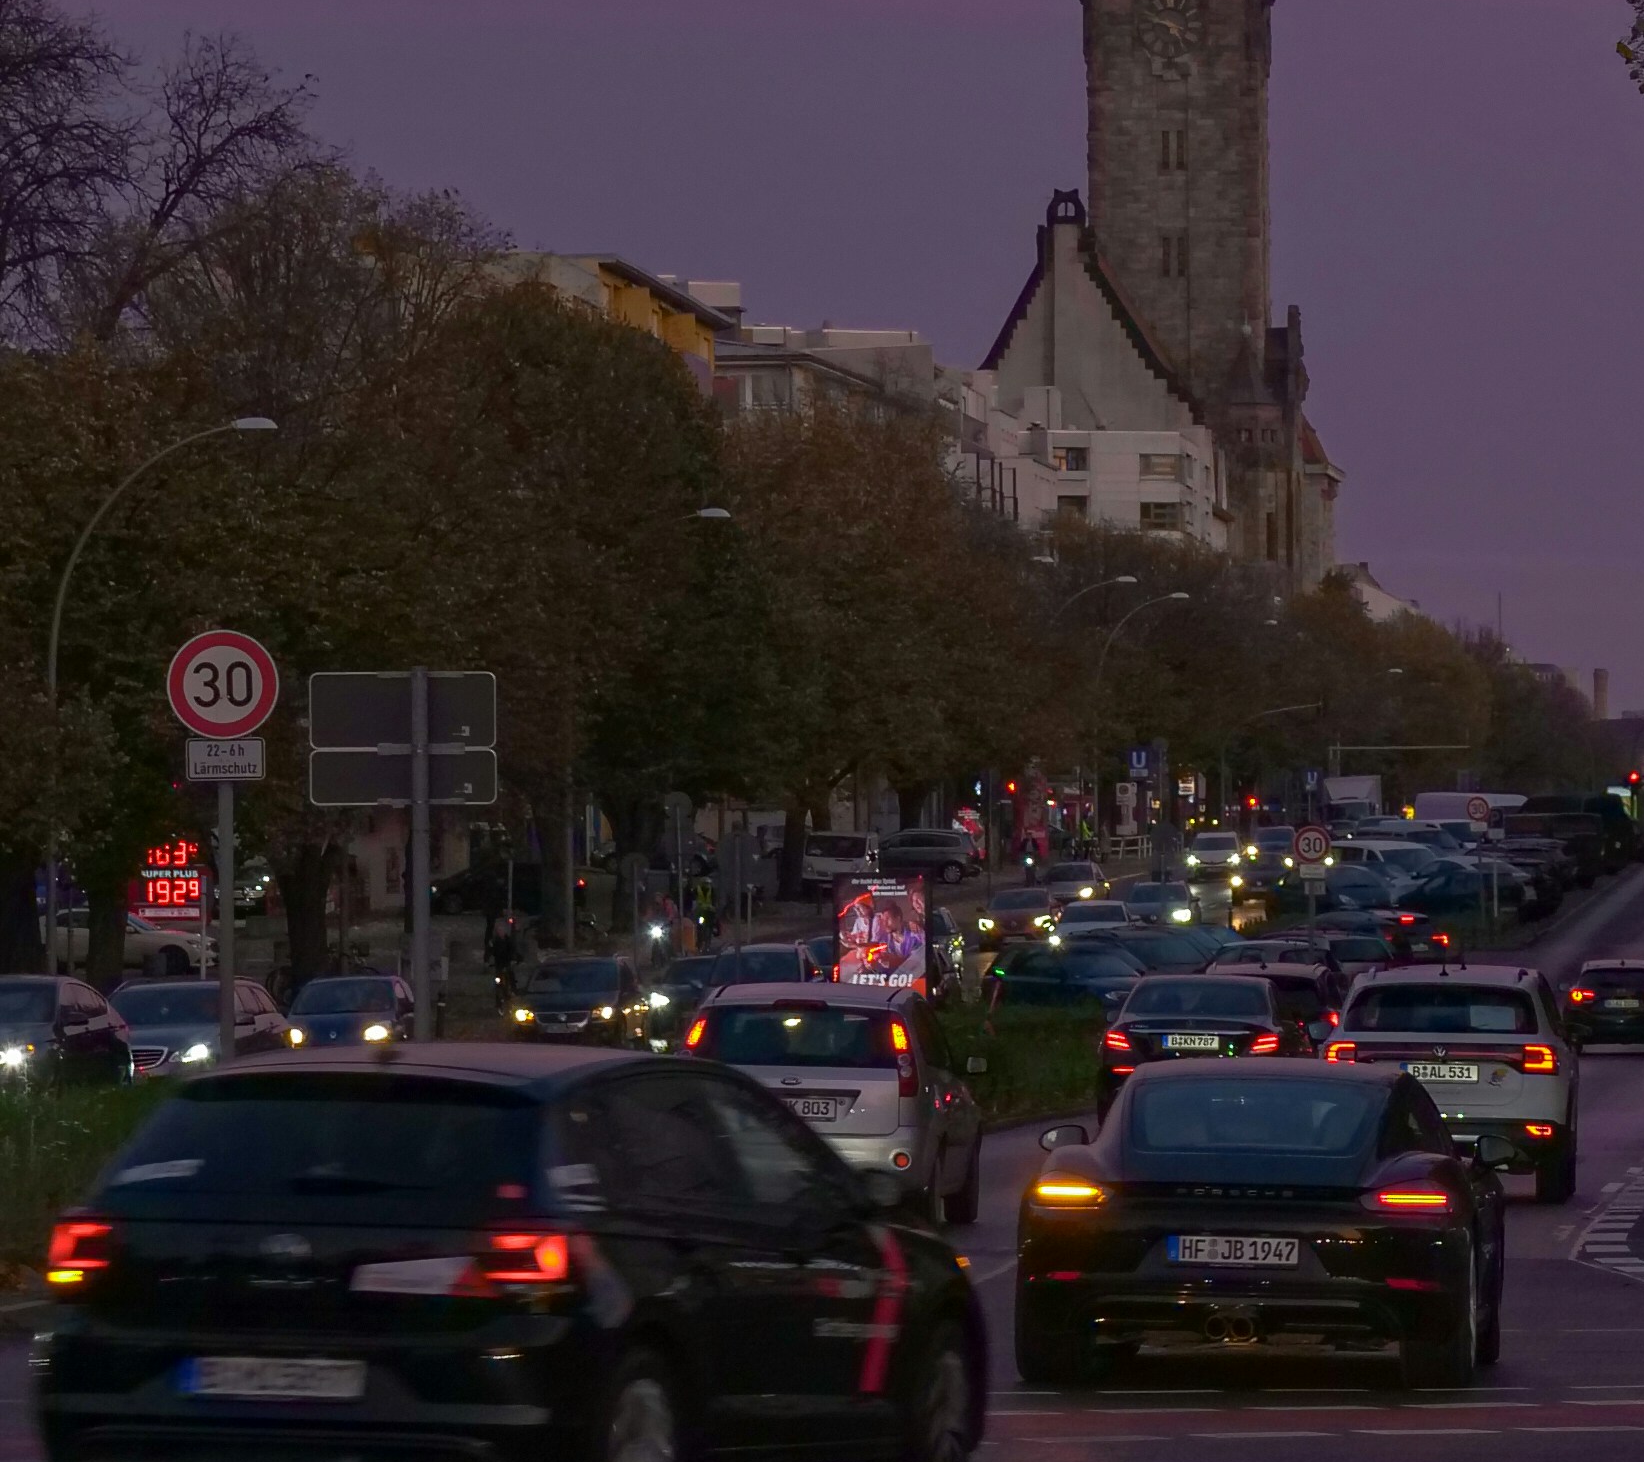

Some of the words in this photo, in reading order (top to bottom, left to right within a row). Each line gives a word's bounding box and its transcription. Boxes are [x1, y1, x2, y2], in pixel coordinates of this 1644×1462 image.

[193, 661, 253, 707] 30
[1132, 751, 1147, 768] U
[194, 761, 257, 775] Lärmschutz
[1470, 803, 1485, 815] 30
[1302, 837, 1323, 853] 30
[147, 880, 199, 904] 1929
[852, 974, 887, 986] LET'S
[889, 974, 913, 987] GO!
[1412, 1066, 1420, 1077] B
[1430, 1066, 1446, 1078] AL
[1448, 1066, 1472, 1079] 531
[802, 1101, 830, 1115] 803
[1181, 1238, 1207, 1260] HF
[1221, 1239, 1245, 1260] JB
[1248, 1240, 1296, 1262] 1947
